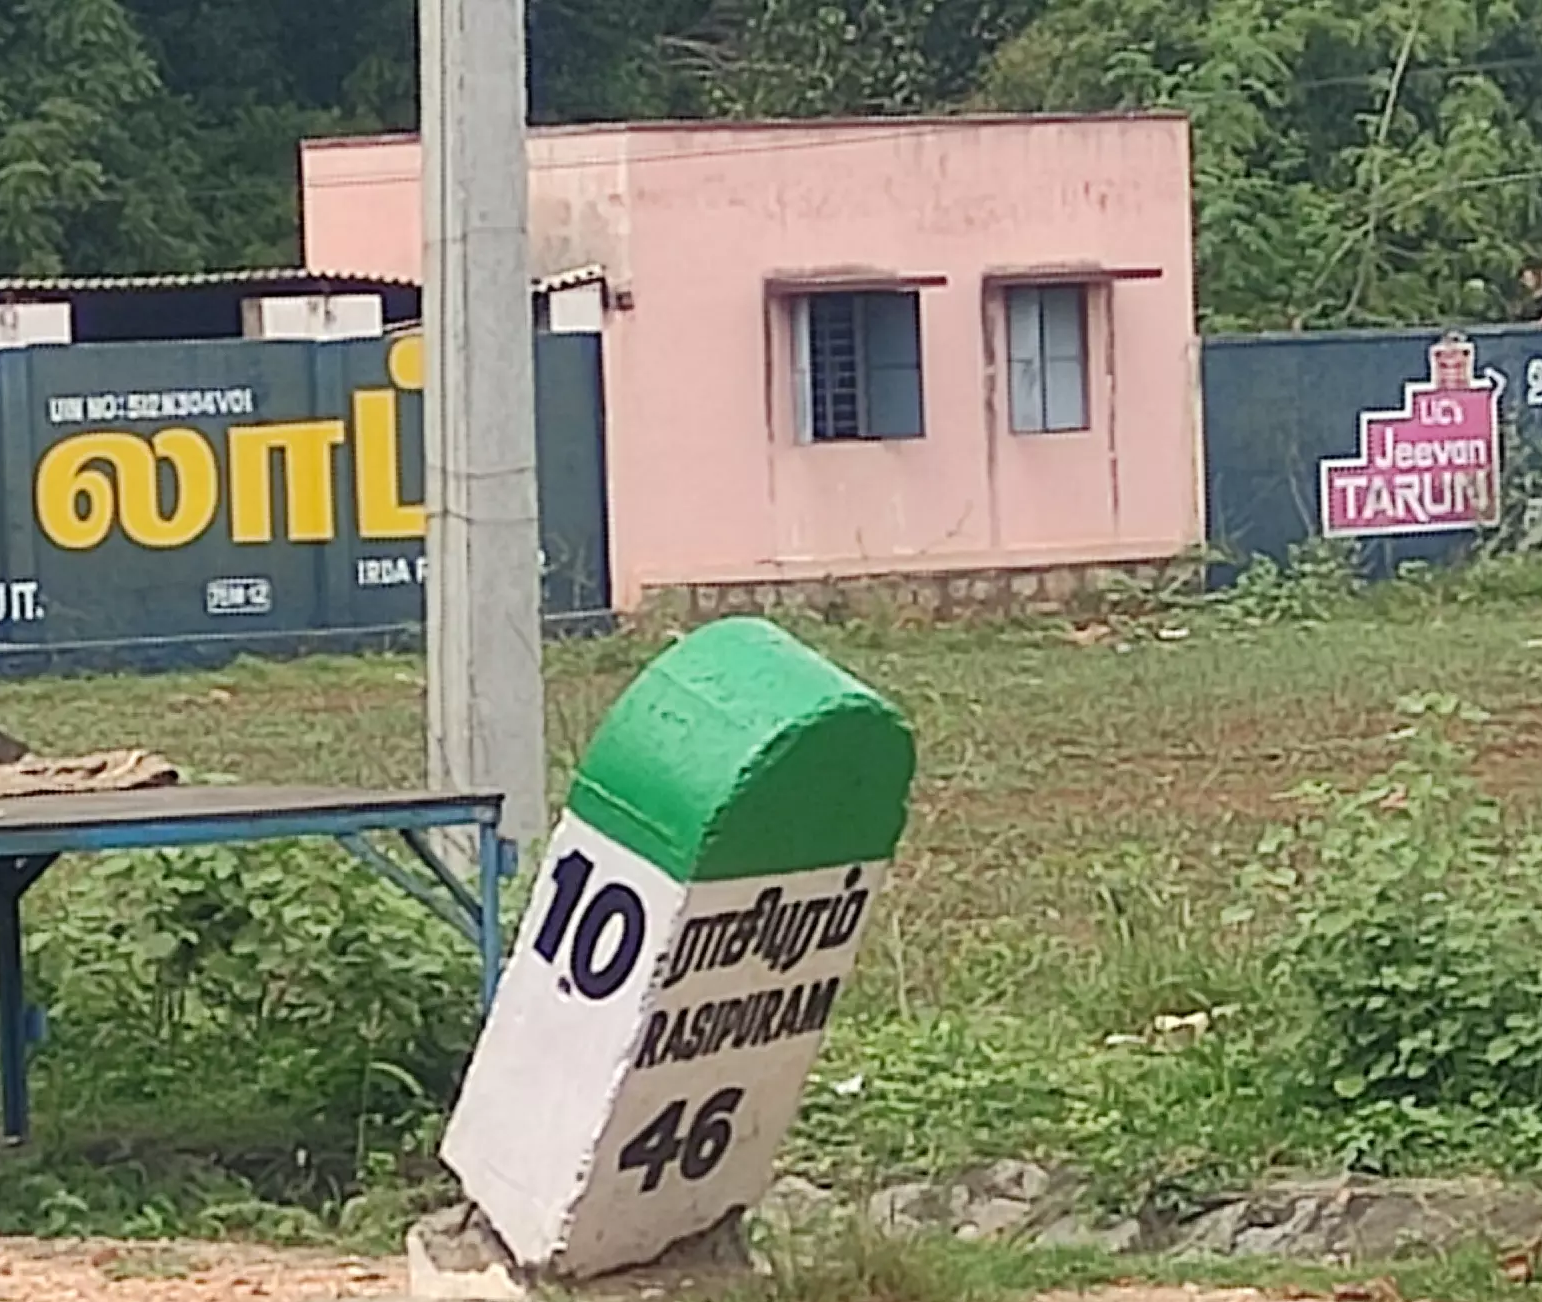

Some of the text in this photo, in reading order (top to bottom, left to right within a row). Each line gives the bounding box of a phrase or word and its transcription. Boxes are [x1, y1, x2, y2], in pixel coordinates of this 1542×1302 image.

[1334, 468, 1491, 522] TARUN
[1374, 426, 1488, 469] Jeevan
[532, 848, 647, 1001] 10
[661, 866, 869, 990] ராசிபுரம்
[633, 975, 841, 1069] RASIPURAM
[616, 1087, 746, 1194] 46
